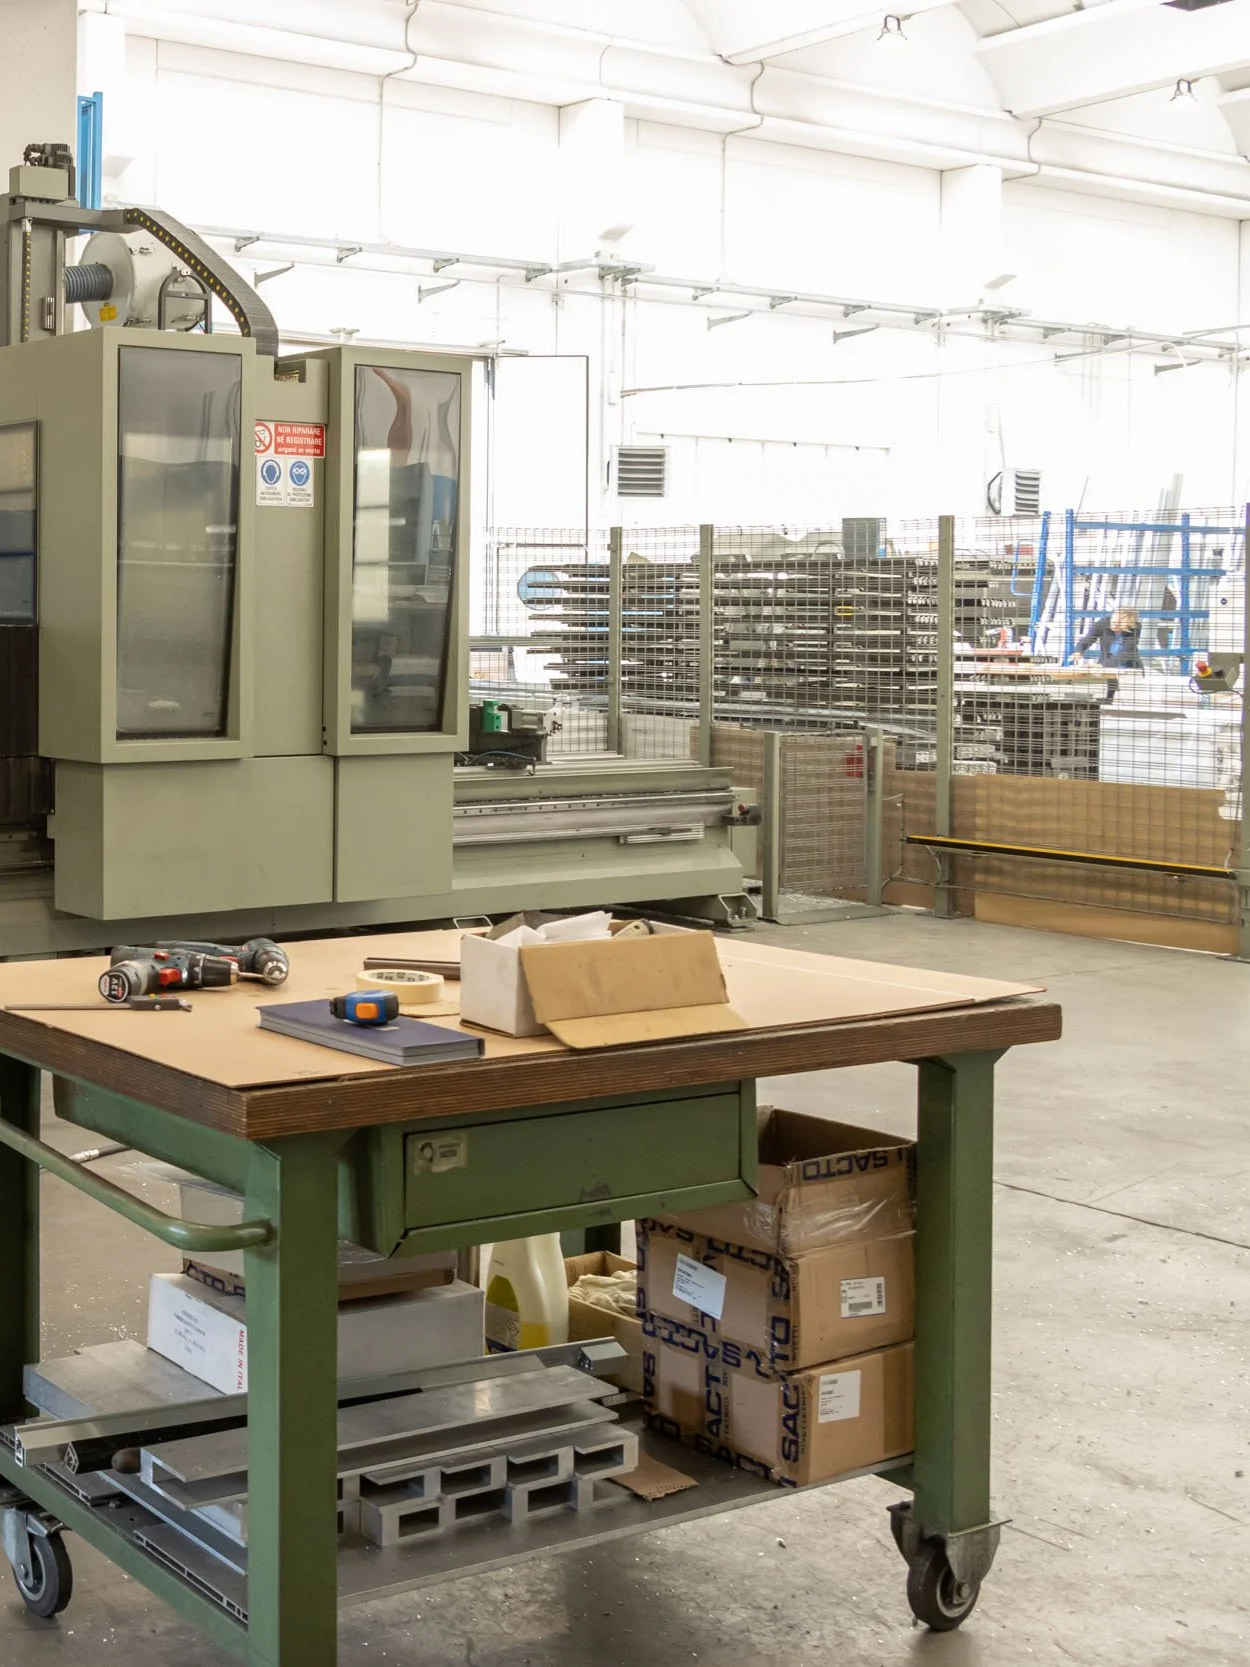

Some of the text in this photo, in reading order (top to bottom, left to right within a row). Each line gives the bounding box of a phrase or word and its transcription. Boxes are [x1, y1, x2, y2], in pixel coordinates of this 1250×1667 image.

[278, 425, 321, 435] NON RIPARARE
[286, 436, 322, 446] REGISTRARE
[111, 978, 119, 995] 12V
[802, 1150, 889, 1181] SACTO
[238, 1359, 244, 1369] IN
